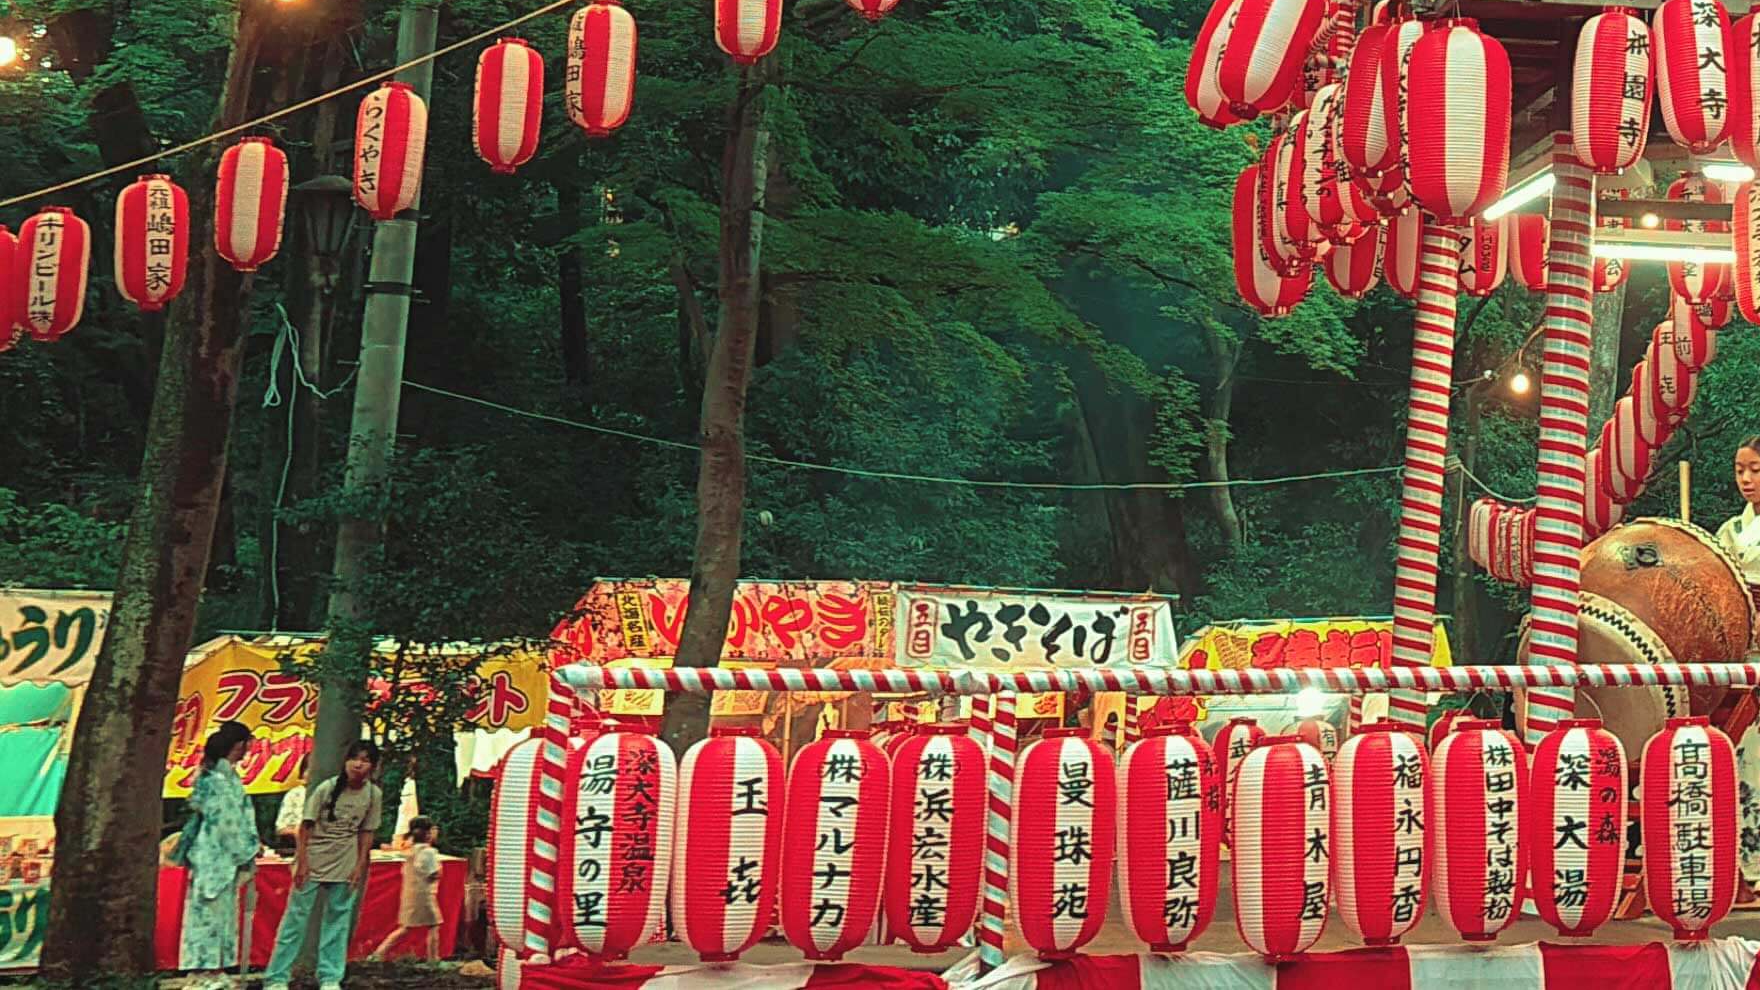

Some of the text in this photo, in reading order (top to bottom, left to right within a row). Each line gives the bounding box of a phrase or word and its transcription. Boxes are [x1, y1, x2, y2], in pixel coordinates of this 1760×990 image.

[1615, 30, 1650, 148] 祇園寺
[1693, 1, 1729, 121] 深大寺
[358, 95, 383, 195] らくやき
[0, 604, 96, 674] うり
[911, 603, 932, 655] 五目
[941, 599, 1129, 666] やきそば
[1132, 610, 1152, 662] 五目
[571, 754, 618, 928] 湯守の里
[616, 748, 657, 894] 深大寺温泉
[1051, 760, 1094, 921] 曼珠苑
[1298, 763, 1331, 921] 青木屋
[1391, 754, 1426, 924] 福永円香
[1553, 753, 1593, 909] 深大湯
